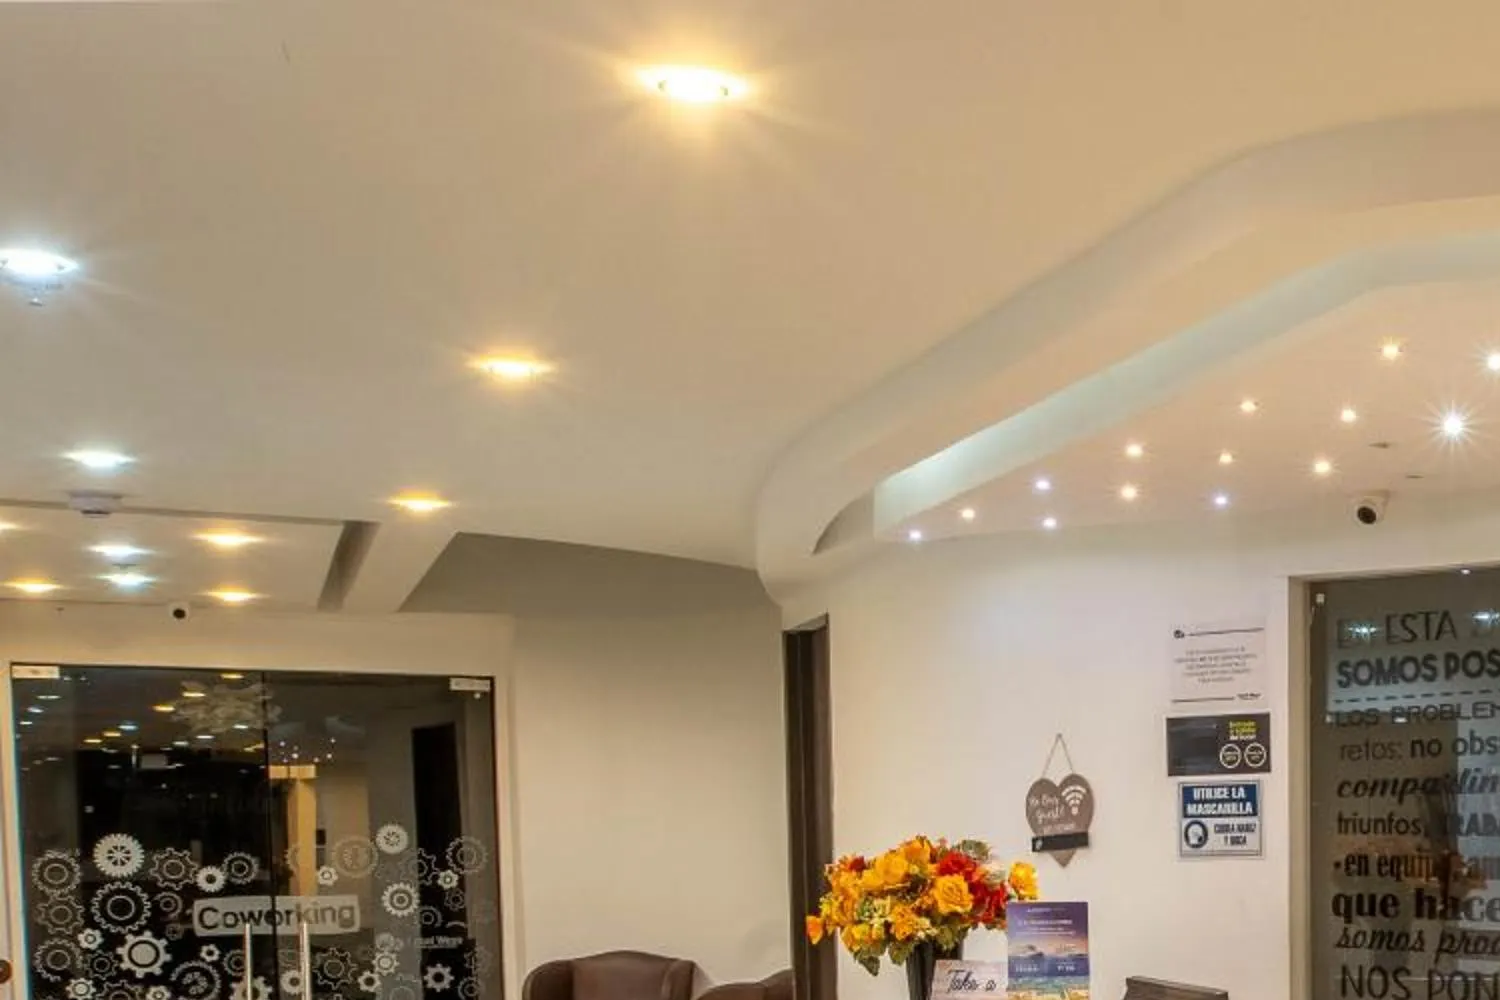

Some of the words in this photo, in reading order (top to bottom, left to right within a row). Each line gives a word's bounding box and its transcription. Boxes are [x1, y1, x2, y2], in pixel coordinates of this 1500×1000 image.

[1337, 617, 1374, 648] E
[1386, 610, 1457, 644] ESTA
[1337, 653, 1437, 688] SOMOS
[1410, 738, 1443, 758] no
[1193, 786, 1230, 800] UTILICE
[1231, 786, 1245, 800] LA
[1187, 802, 1253, 815] MASCARILLA
[199, 901, 355, 930] Coworking
[1331, 891, 1400, 925] que
[1336, 927, 1425, 951] somos
[1341, 965, 1411, 1000] NOS
